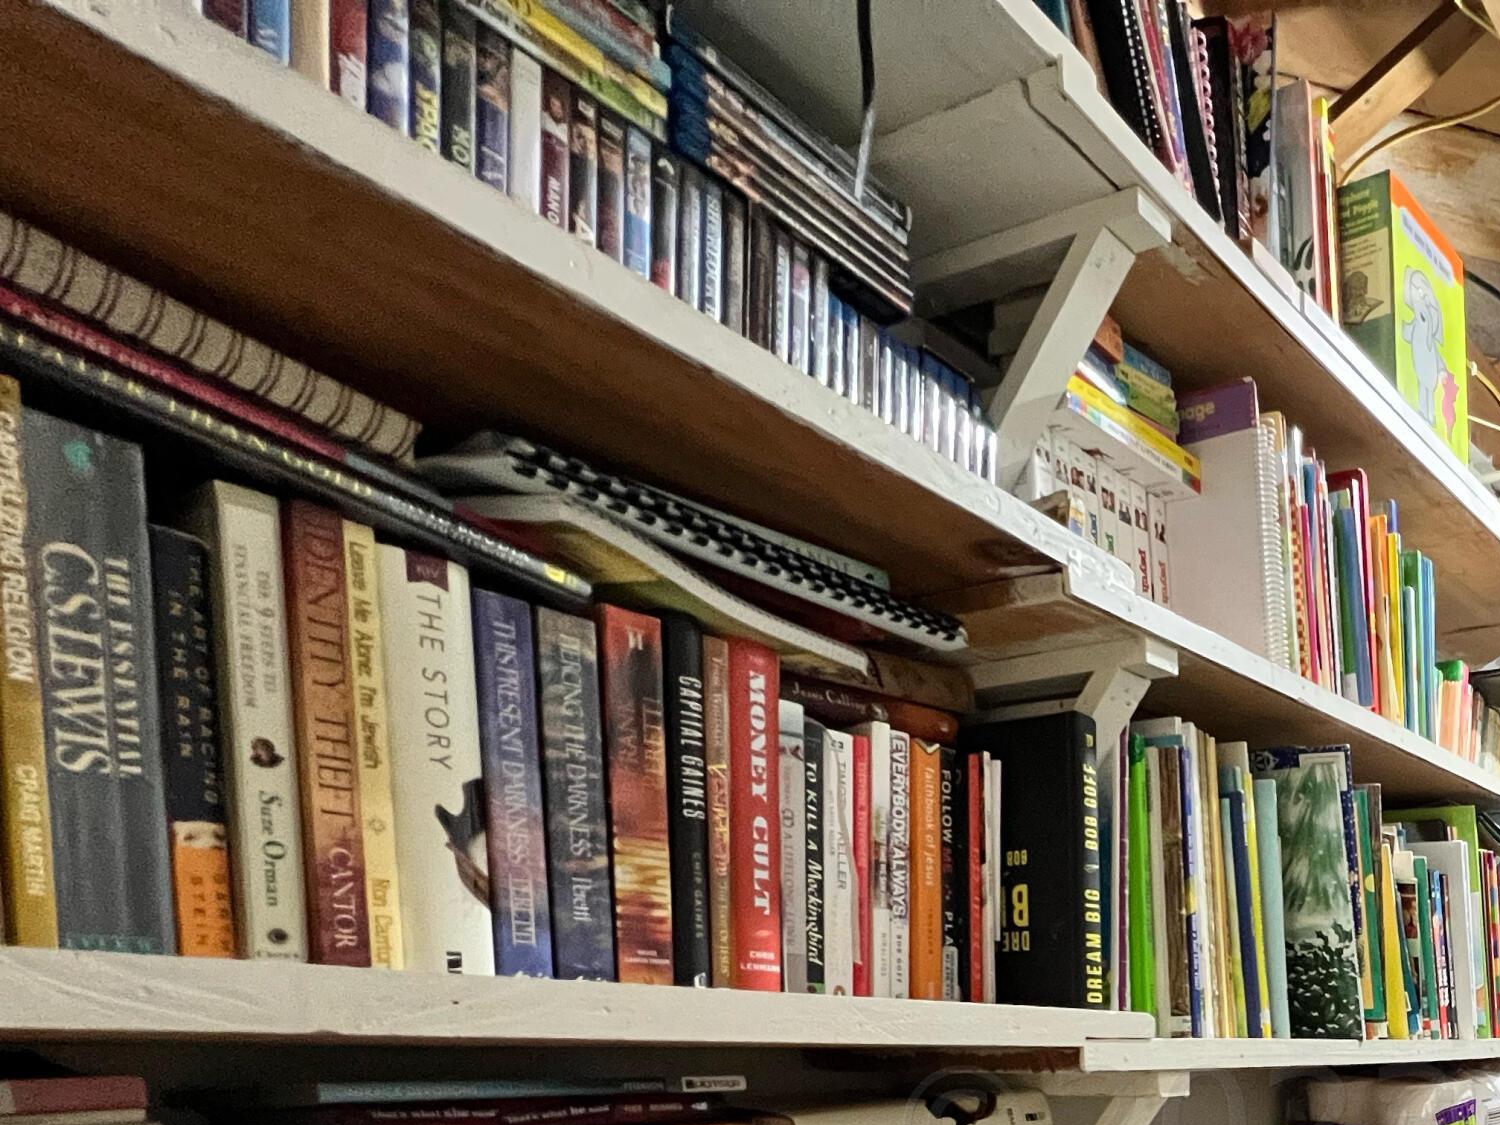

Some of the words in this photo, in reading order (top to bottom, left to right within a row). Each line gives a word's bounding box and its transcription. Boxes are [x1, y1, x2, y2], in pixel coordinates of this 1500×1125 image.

[4, 575, 34, 680] RELIGION
[417, 593, 445, 653] THE
[48, 624, 112, 775] LEWIS
[420, 667, 454, 771] STORY
[678, 674, 704, 753] CAPITAL
[748, 669, 769, 803] MONEY
[313, 714, 356, 826] THEFT
[680, 755, 706, 821] GAINES
[804, 761, 817, 783] TO
[922, 767, 936, 830] faithbook
[1083, 762, 1098, 809] GOFF
[258, 790, 282, 835] Suze
[806, 788, 819, 833] KILL
[941, 769, 954, 843] FOLLOW
[1084, 815, 1099, 851] BOB
[262, 840, 287, 907] Orman
[752, 815, 771, 917] CULT
[808, 840, 818, 852] A
[923, 850, 936, 886] jesus
[327, 848, 359, 949] CANTOR
[805, 858, 825, 966] Mockingbird
[892, 849, 907, 917] ALWAYS
[1084, 887, 1101, 924] BIG
[1086, 934, 1102, 1004] DREAM
